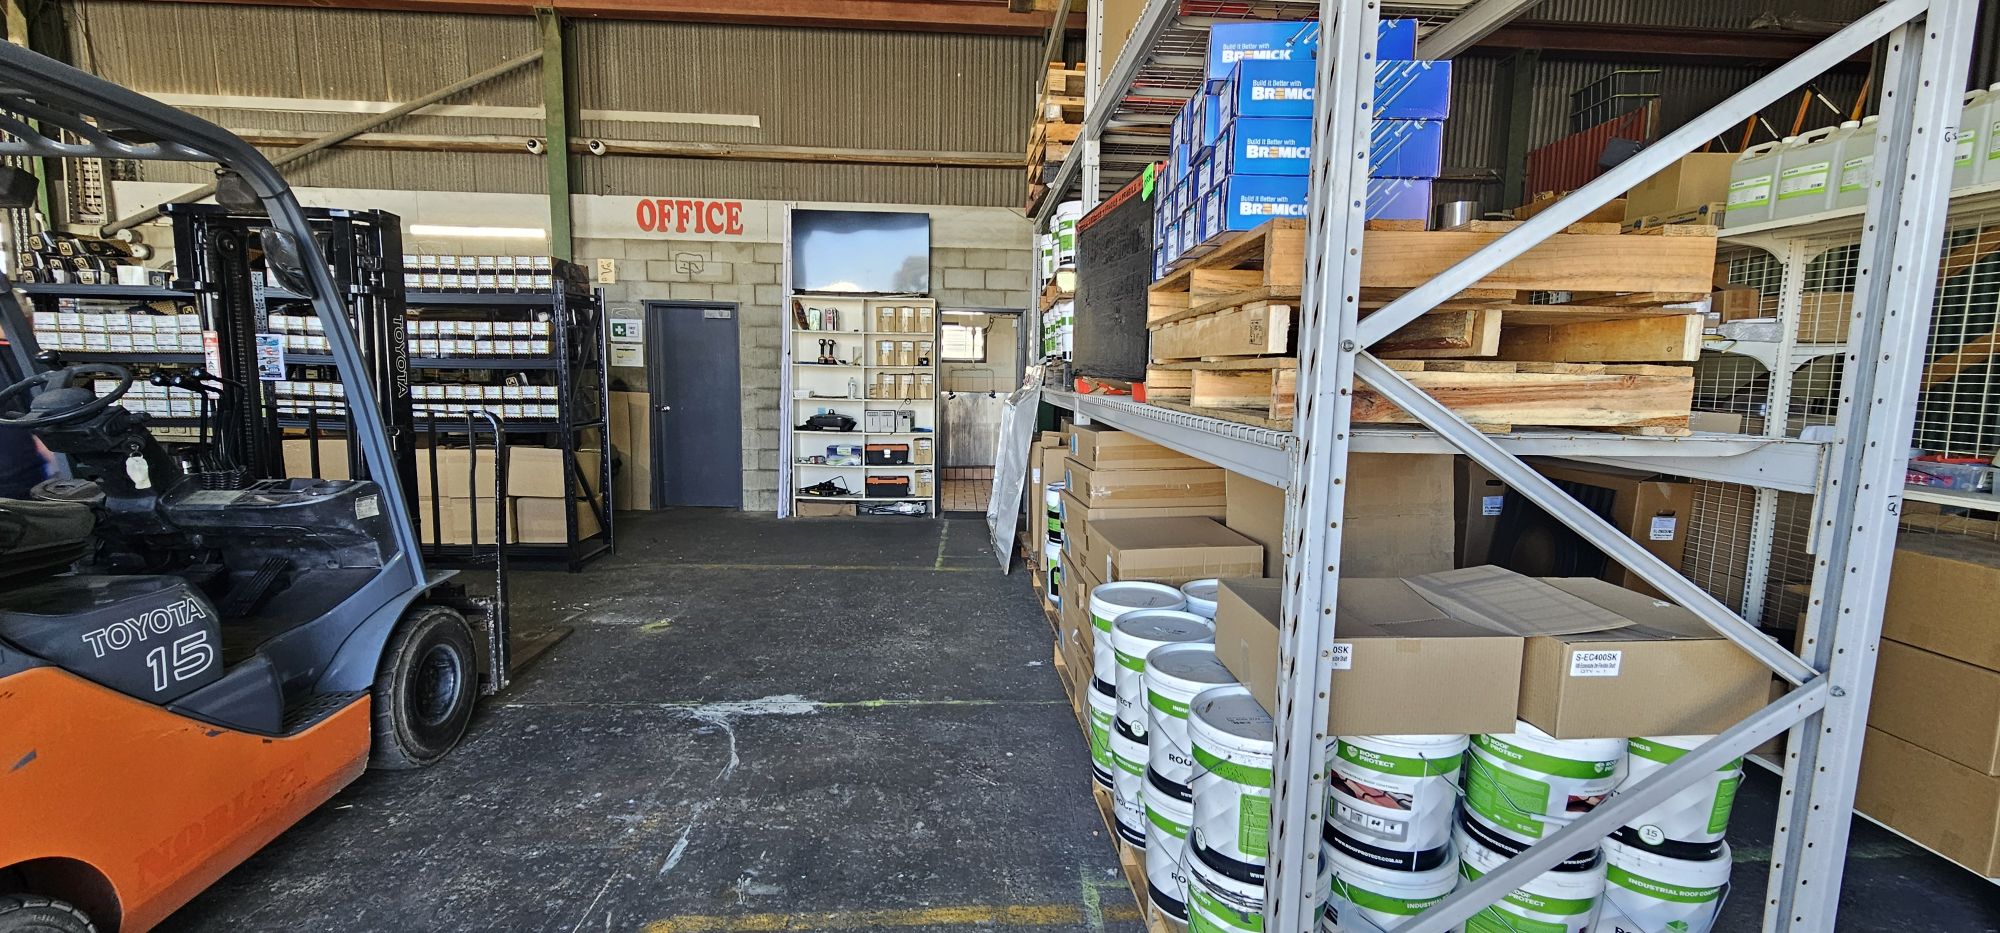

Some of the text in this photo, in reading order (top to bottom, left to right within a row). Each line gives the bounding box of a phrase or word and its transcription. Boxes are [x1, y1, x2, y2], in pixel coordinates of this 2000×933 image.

[1252, 79, 1267, 87] Build
[1272, 79, 1290, 87] Better
[1290, 79, 1302, 87] with
[1251, 86, 1315, 100] BREMIC
[1246, 137, 1261, 145] Build
[1266, 138, 1283, 146] Better
[1240, 194, 1255, 202] Build
[1259, 195, 1277, 203] Better
[636, 198, 744, 235] OFFICE
[393, 314, 409, 399] TOYOTA
[82, 597, 206, 658] TOYOTA
[146, 630, 214, 692] 15
[1575, 653, 1618, 662] S-EC400SK
[1359, 755, 1396, 768] PROTECT
[1645, 828, 1658, 838] 15
[1628, 877, 1679, 896] INDUSTRIAL
